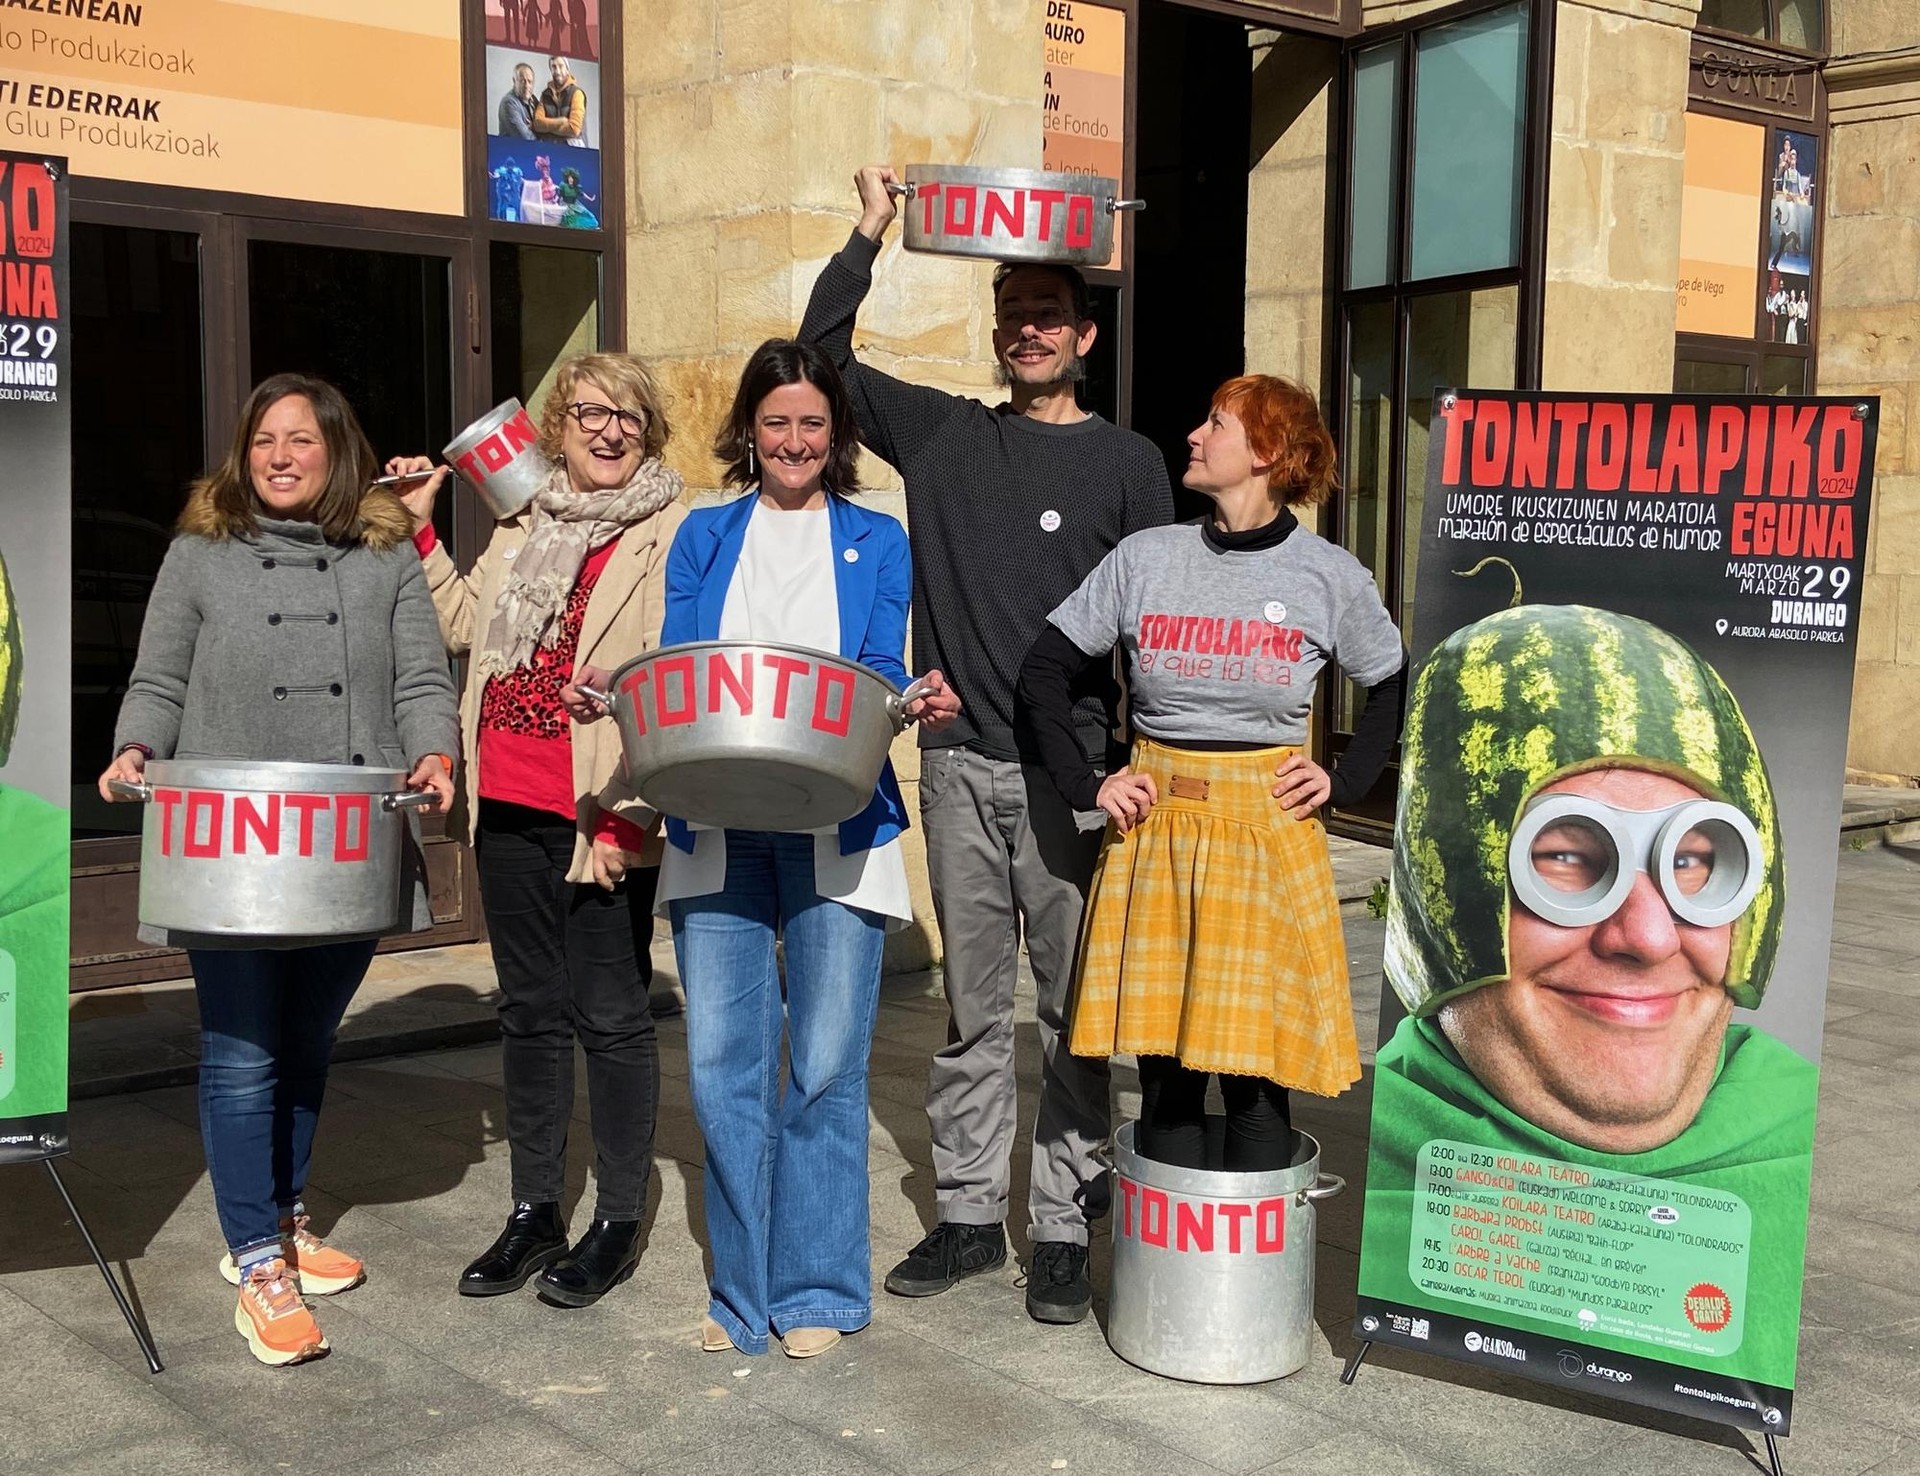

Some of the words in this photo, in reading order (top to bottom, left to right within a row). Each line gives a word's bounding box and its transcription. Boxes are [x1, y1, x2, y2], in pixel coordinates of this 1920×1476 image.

[0, 0, 142, 27] AZENEAN
[1047, 1, 1073, 21] DEL
[32, 28, 195, 75] Produkzioak
[27, 84, 161, 123] EDERRAK
[6, 110, 49, 139] Glu
[60, 117, 221, 159] Produkzioak
[1064, 114, 1109, 138] Fondo
[917, 182, 1094, 249] TONTO
[0, 262, 58, 319] NA
[1691, 277, 1702, 292] de
[1704, 279, 1724, 298] Vega
[10, 323, 58, 359] 29
[23, 389, 58, 402] PARKEA
[455, 406, 541, 485] TON
[1440, 399, 1864, 499] TONTOLAPIKO
[1819, 477, 1855, 495] 2024
[1446, 493, 1504, 516] UMORE
[1511, 495, 1618, 521] IKUSKIZUNEN
[1624, 500, 1717, 525] MARATOIA
[1730, 502, 1855, 559] EGUNA
[1725, 562, 1801, 581] MARTXOAK
[1802, 565, 1851, 599] 29
[1739, 578, 1799, 597] MARZO
[1770, 600, 1847, 627] DURANGO
[1731, 626, 1766, 638] AURORA
[1768, 627, 1808, 641] ABASOLO
[1810, 630, 1845, 644] PARKEA
[1164, 655, 1214, 679] que
[1222, 654, 1244, 682] lo
[620, 652, 857, 738] TONTO
[154, 789, 371, 863] TONTO
[0, 1135, 33, 1144] oeguna
[1430, 1145, 1455, 1160] 12:00
[1470, 1153, 1494, 1168] 12:30
[1496, 1156, 1542, 1176] KOILARA
[1548, 1165, 1590, 1186] TEATRO
[1429, 1163, 1453, 1179] 13:00
[1610, 1201, 1616, 1211] &
[1119, 1176, 1286, 1255] TONTO
[1426, 1201, 1451, 1216] 18:00
[1502, 1196, 1547, 1216] KOILARA
[1553, 1205, 1596, 1226] TEATRO
[1451, 1223, 1483, 1242] CAROL
[1488, 1231, 1521, 1250] GAREL
[1453, 1261, 1488, 1281] OSCAR
[1493, 1269, 1525, 1289] TEROL
[1586, 1362, 1633, 1383] durango
[1674, 1383, 1757, 1410] #tontolapikoeguna
